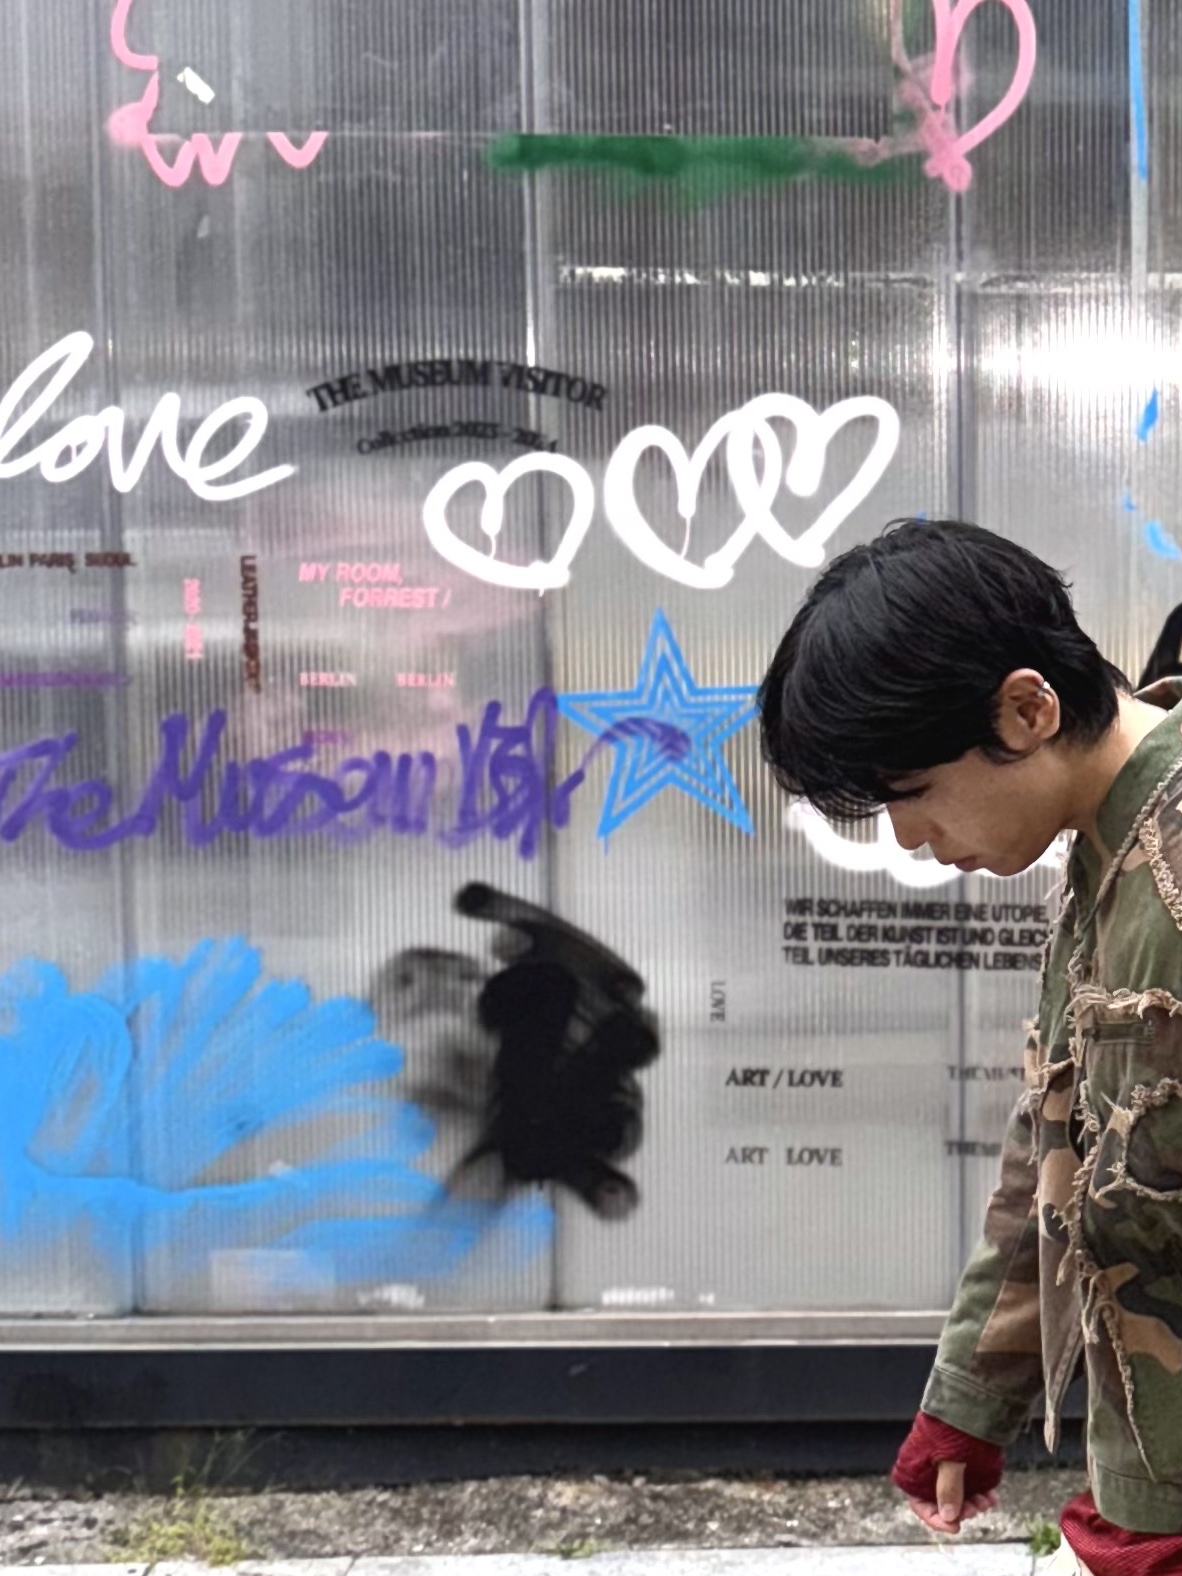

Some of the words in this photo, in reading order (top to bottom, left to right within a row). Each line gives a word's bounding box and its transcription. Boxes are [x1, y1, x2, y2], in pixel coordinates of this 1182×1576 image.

[306, 373, 368, 412] THE
[366, 359, 494, 396] MUSEUM
[497, 361, 606, 410] VISITOR
[0, 330, 297, 501] love
[298, 563, 330, 582] MY
[817, 898, 897, 918] SCHAFFEN
[901, 902, 949, 919] IMMER
[846, 924, 878, 943] DER
[817, 946, 890, 967] UNSERES
[710, 980, 726, 1023] LOVE
[725, 1067, 770, 1088] ART
[787, 1069, 844, 1088] LOVE
[725, 1146, 770, 1165] ART
[785, 1147, 843, 1166] LOVE
